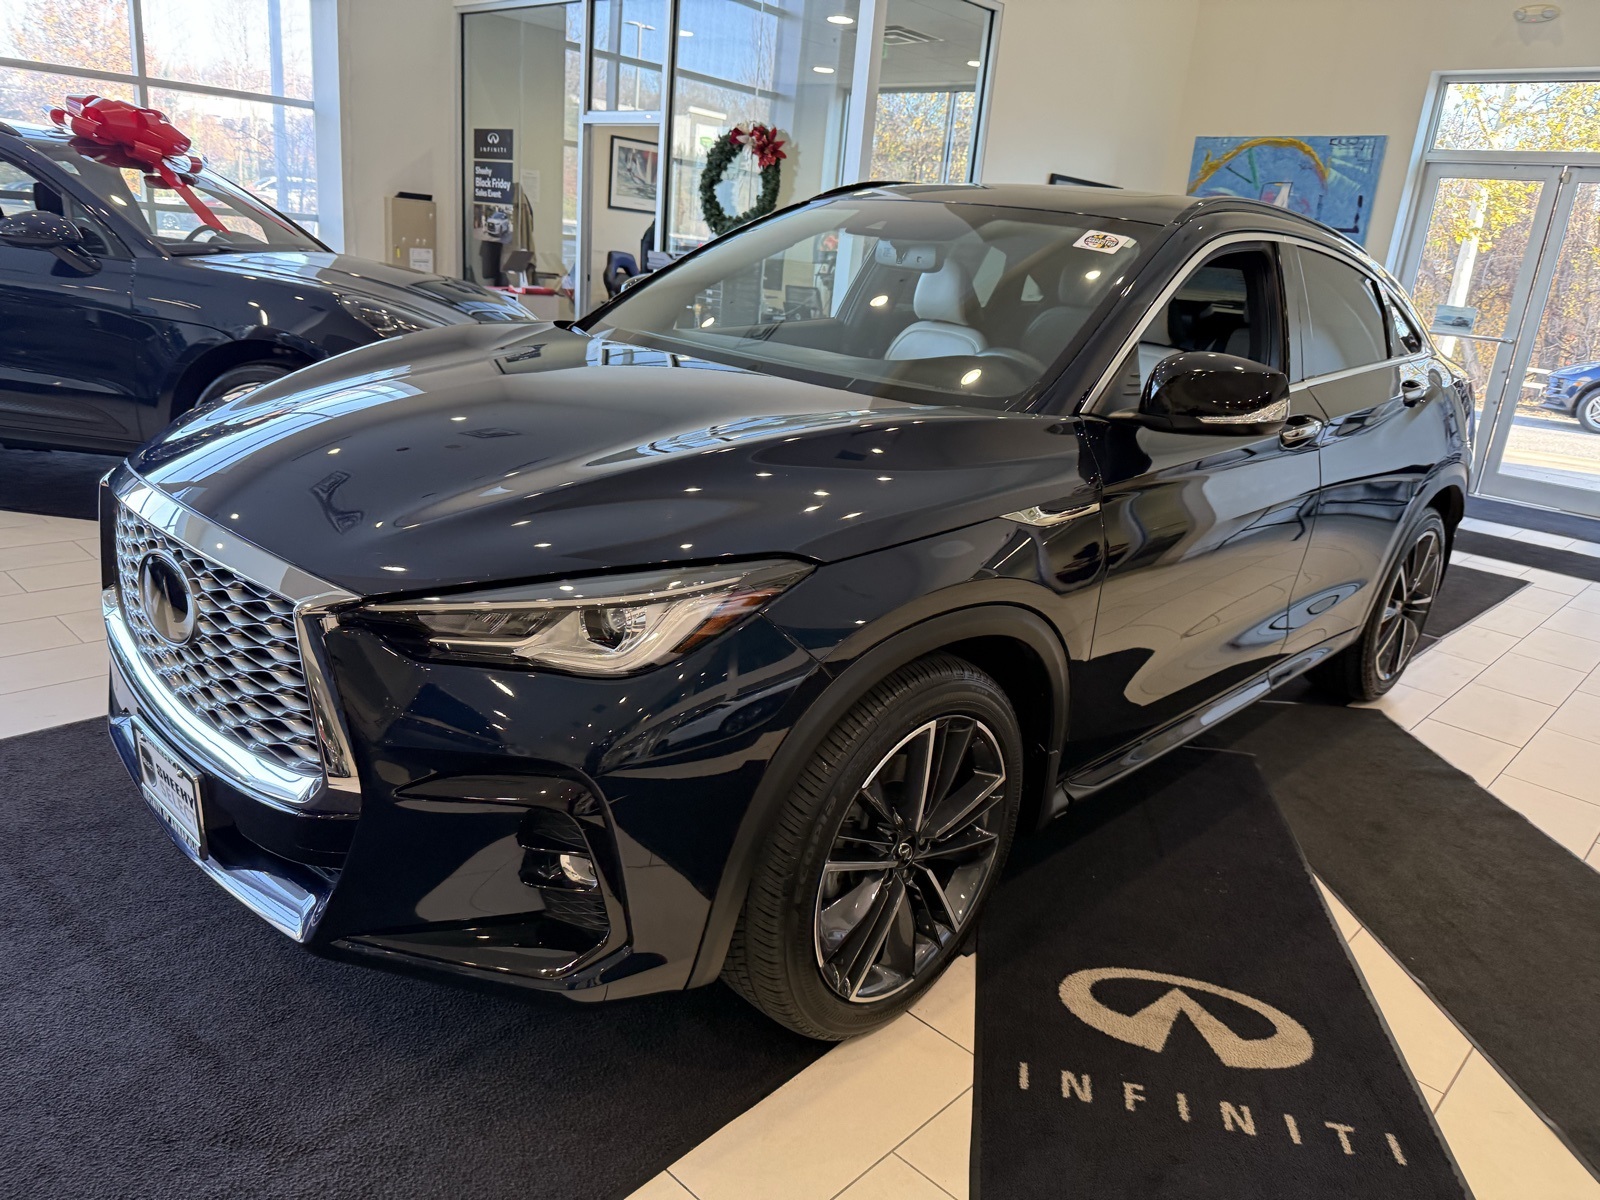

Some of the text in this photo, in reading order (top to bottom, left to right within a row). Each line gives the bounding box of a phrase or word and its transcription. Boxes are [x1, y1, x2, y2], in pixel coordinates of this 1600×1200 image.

[475, 166, 492, 177] Sheehy
[475, 177, 491, 187] Black
[491, 178, 511, 191] Friday
[475, 188, 502, 198] Sales Event
[156, 763, 194, 810] SHEEHY
[159, 779, 197, 831] SELECT
[1018, 1061, 1408, 1166] INFINITI
